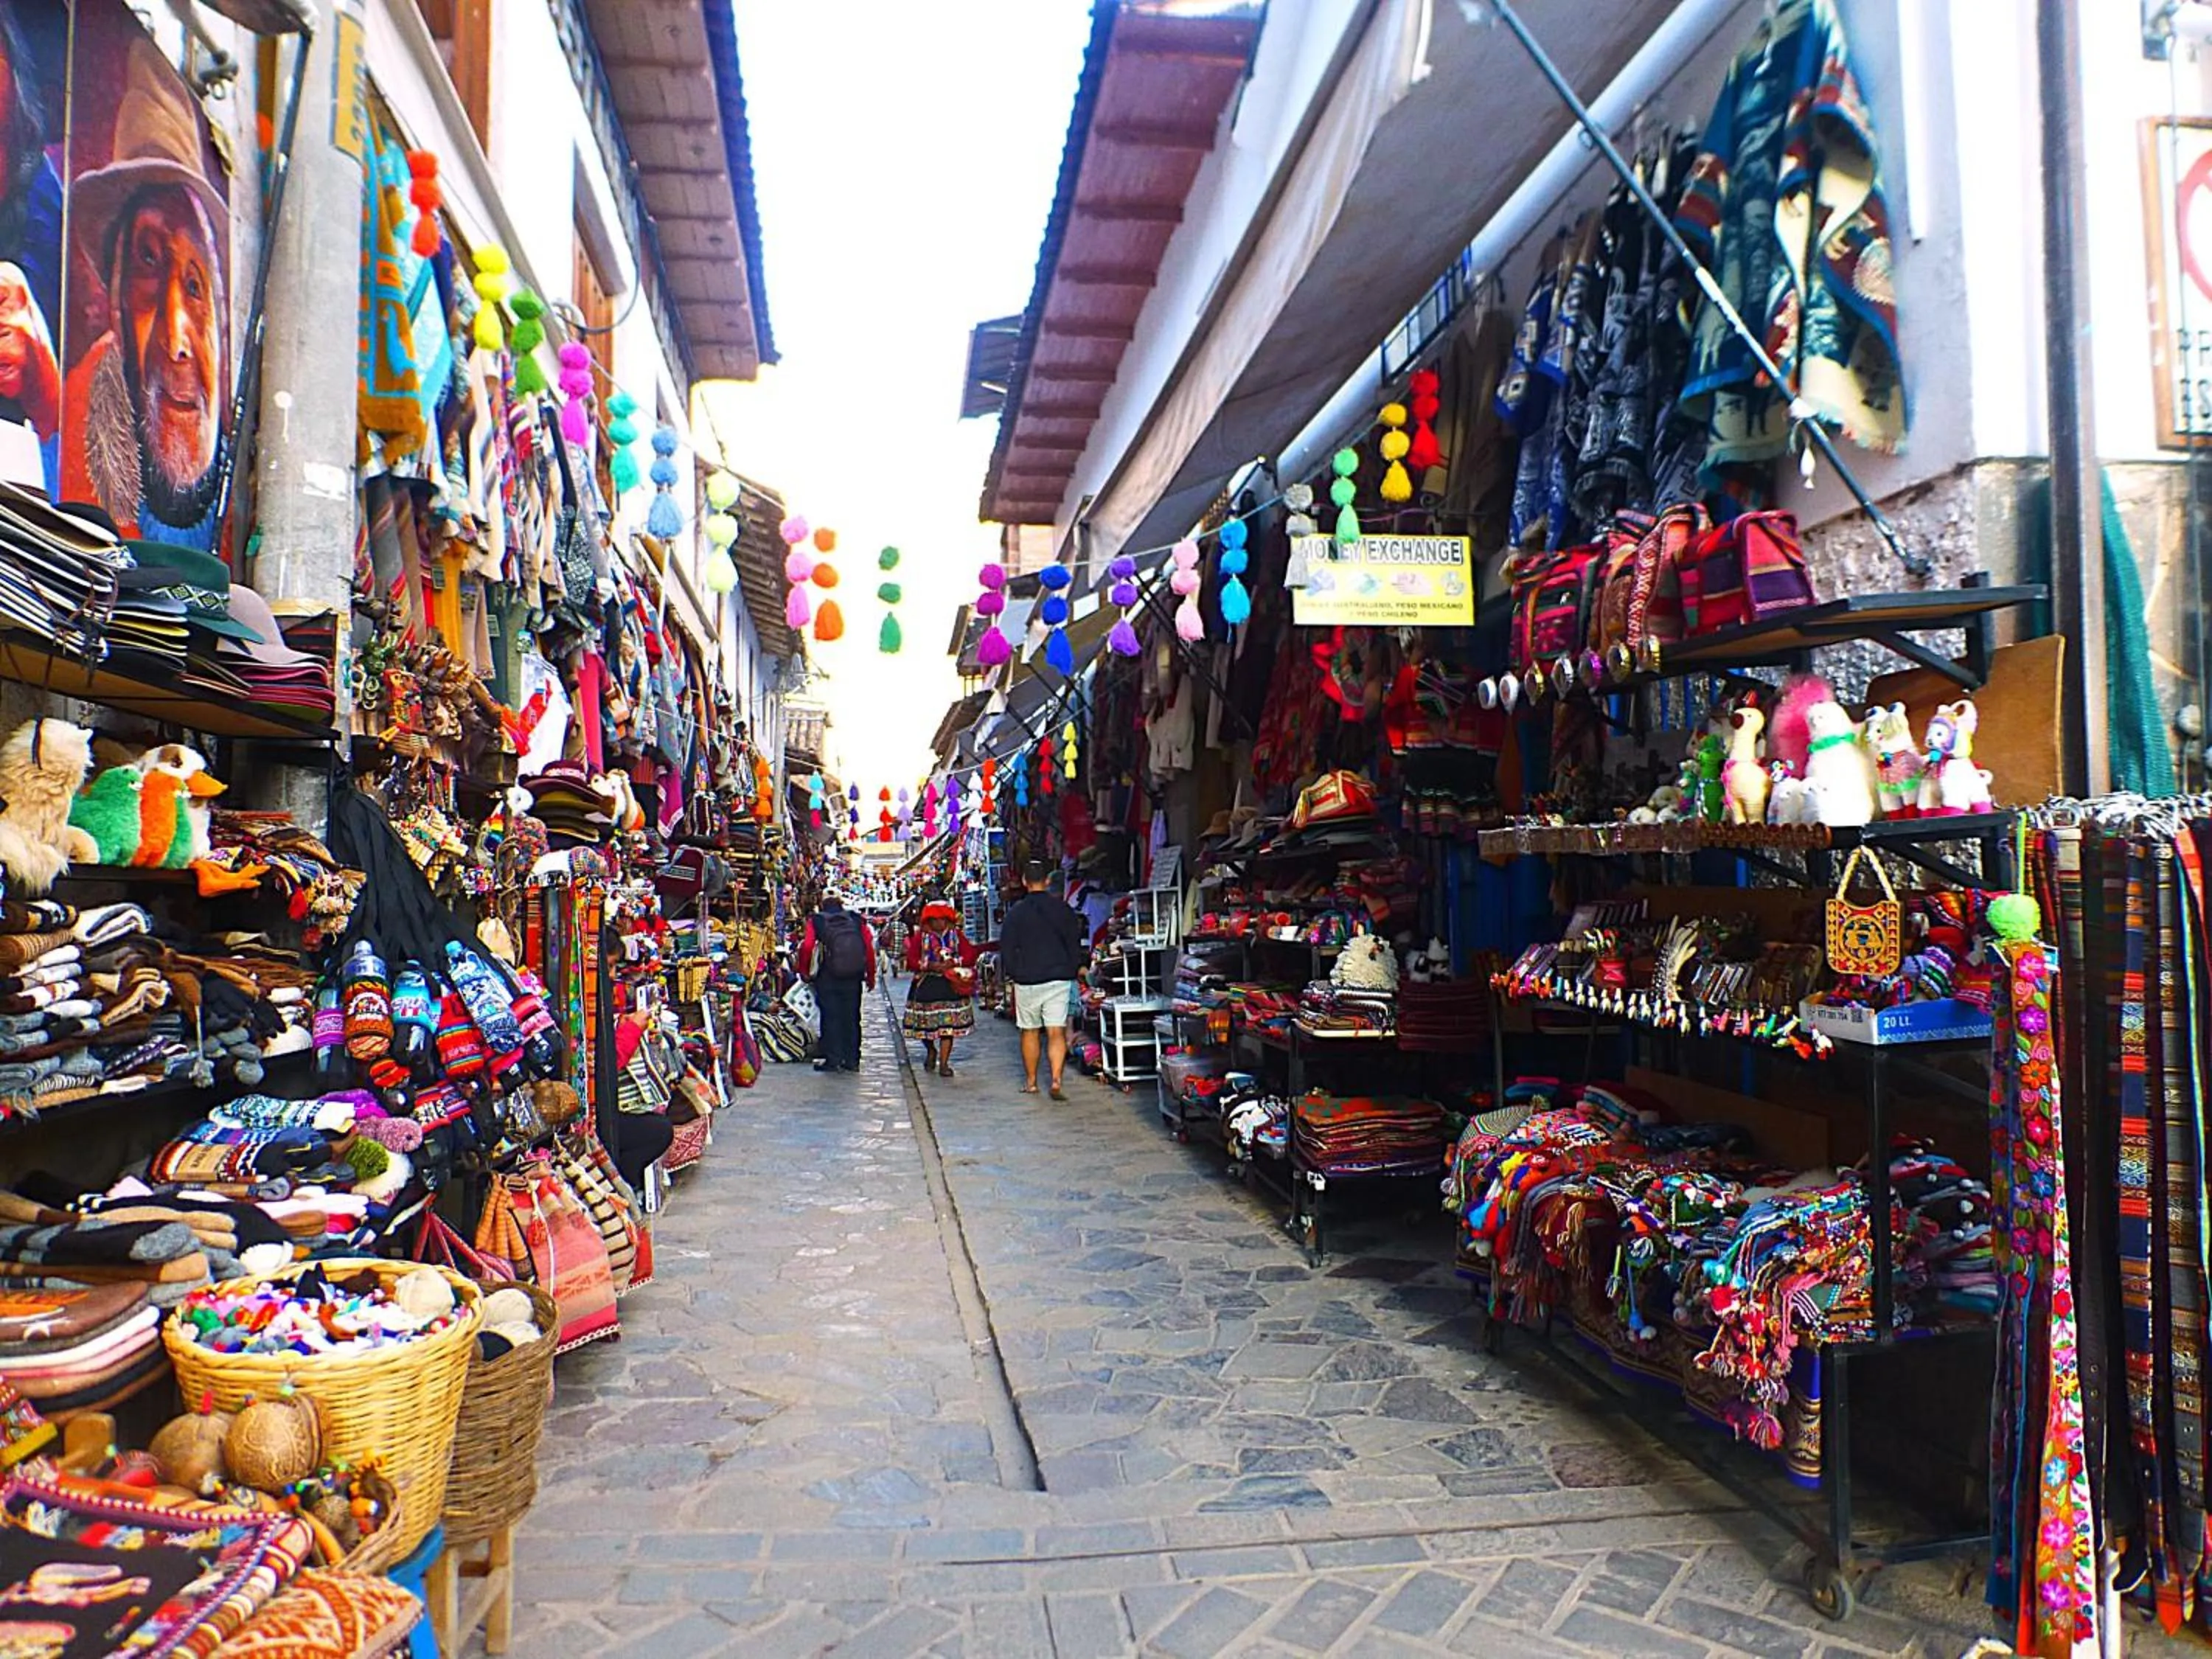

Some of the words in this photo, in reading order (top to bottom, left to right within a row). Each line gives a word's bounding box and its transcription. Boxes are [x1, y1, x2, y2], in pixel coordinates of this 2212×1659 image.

[1299, 538, 1360, 560] MONEY
[1368, 540, 1461, 562] EXCHANGE
[1883, 1017, 1897, 1029] 20
